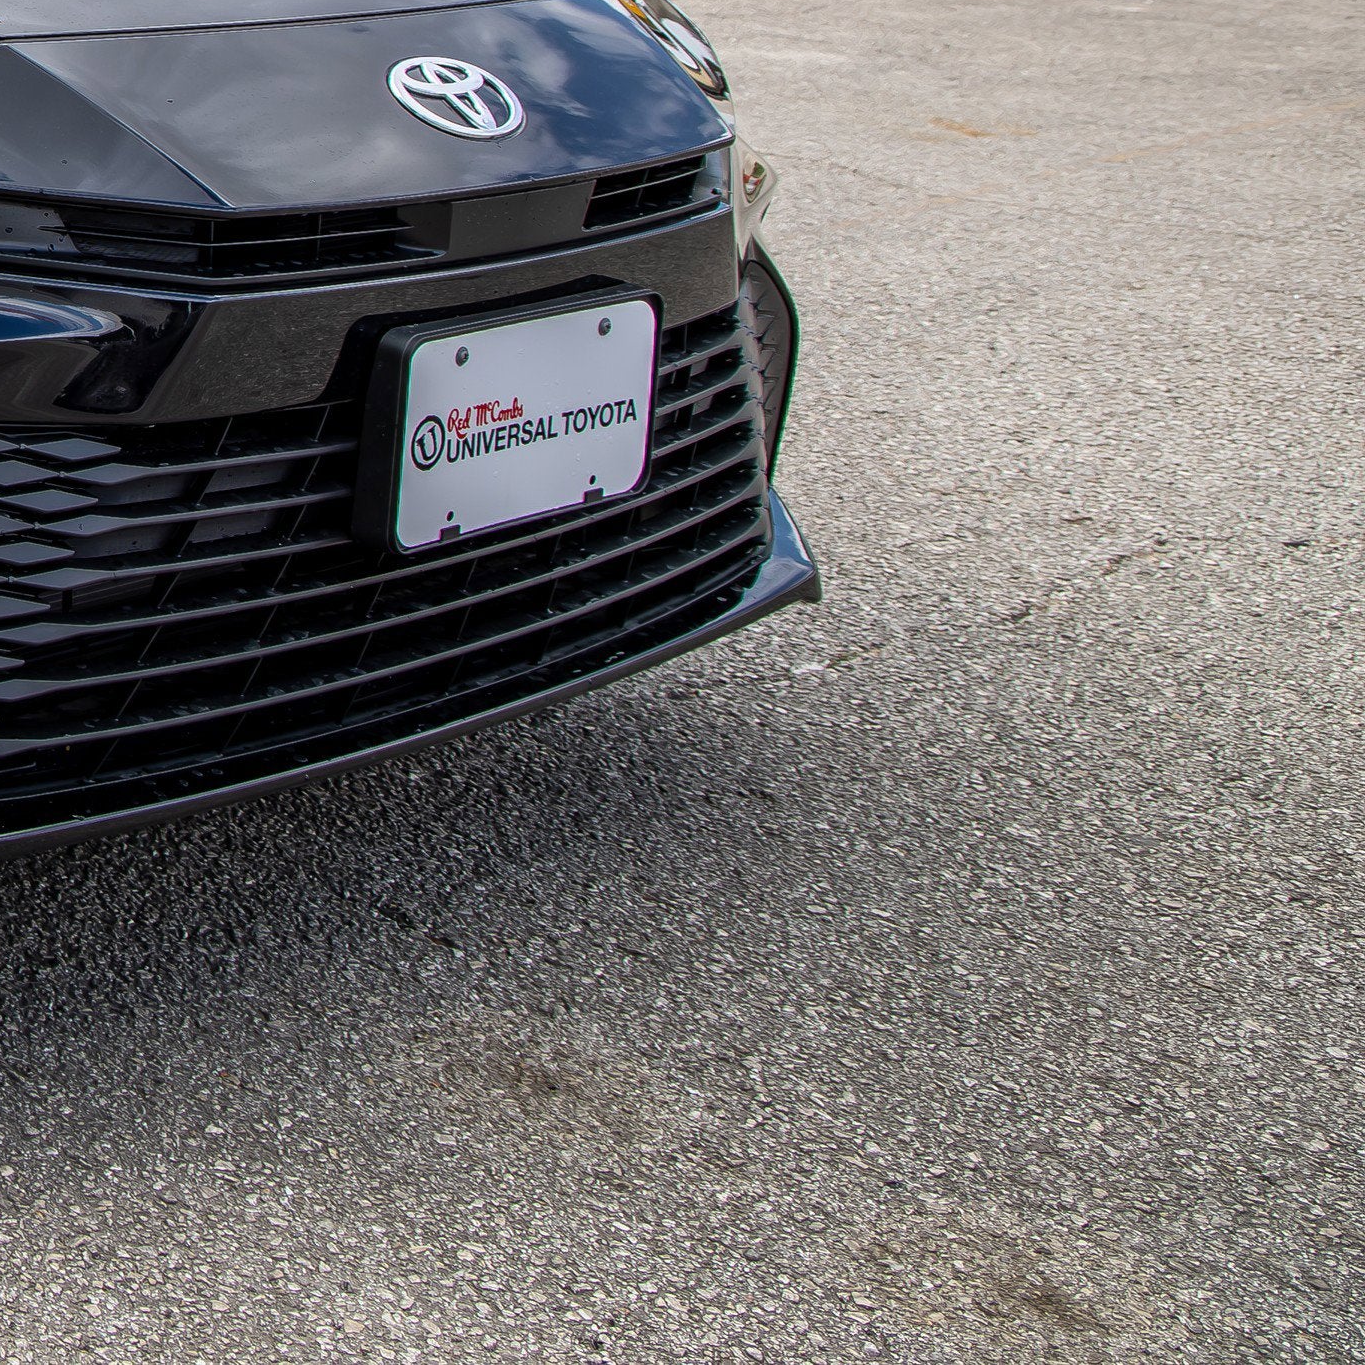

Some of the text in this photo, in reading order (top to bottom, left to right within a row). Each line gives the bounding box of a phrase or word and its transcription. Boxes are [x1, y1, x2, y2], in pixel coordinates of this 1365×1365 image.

[446, 398, 638, 463] UNIVERSAL TOYOTA
[447, 396, 524, 439] Red McCombs
